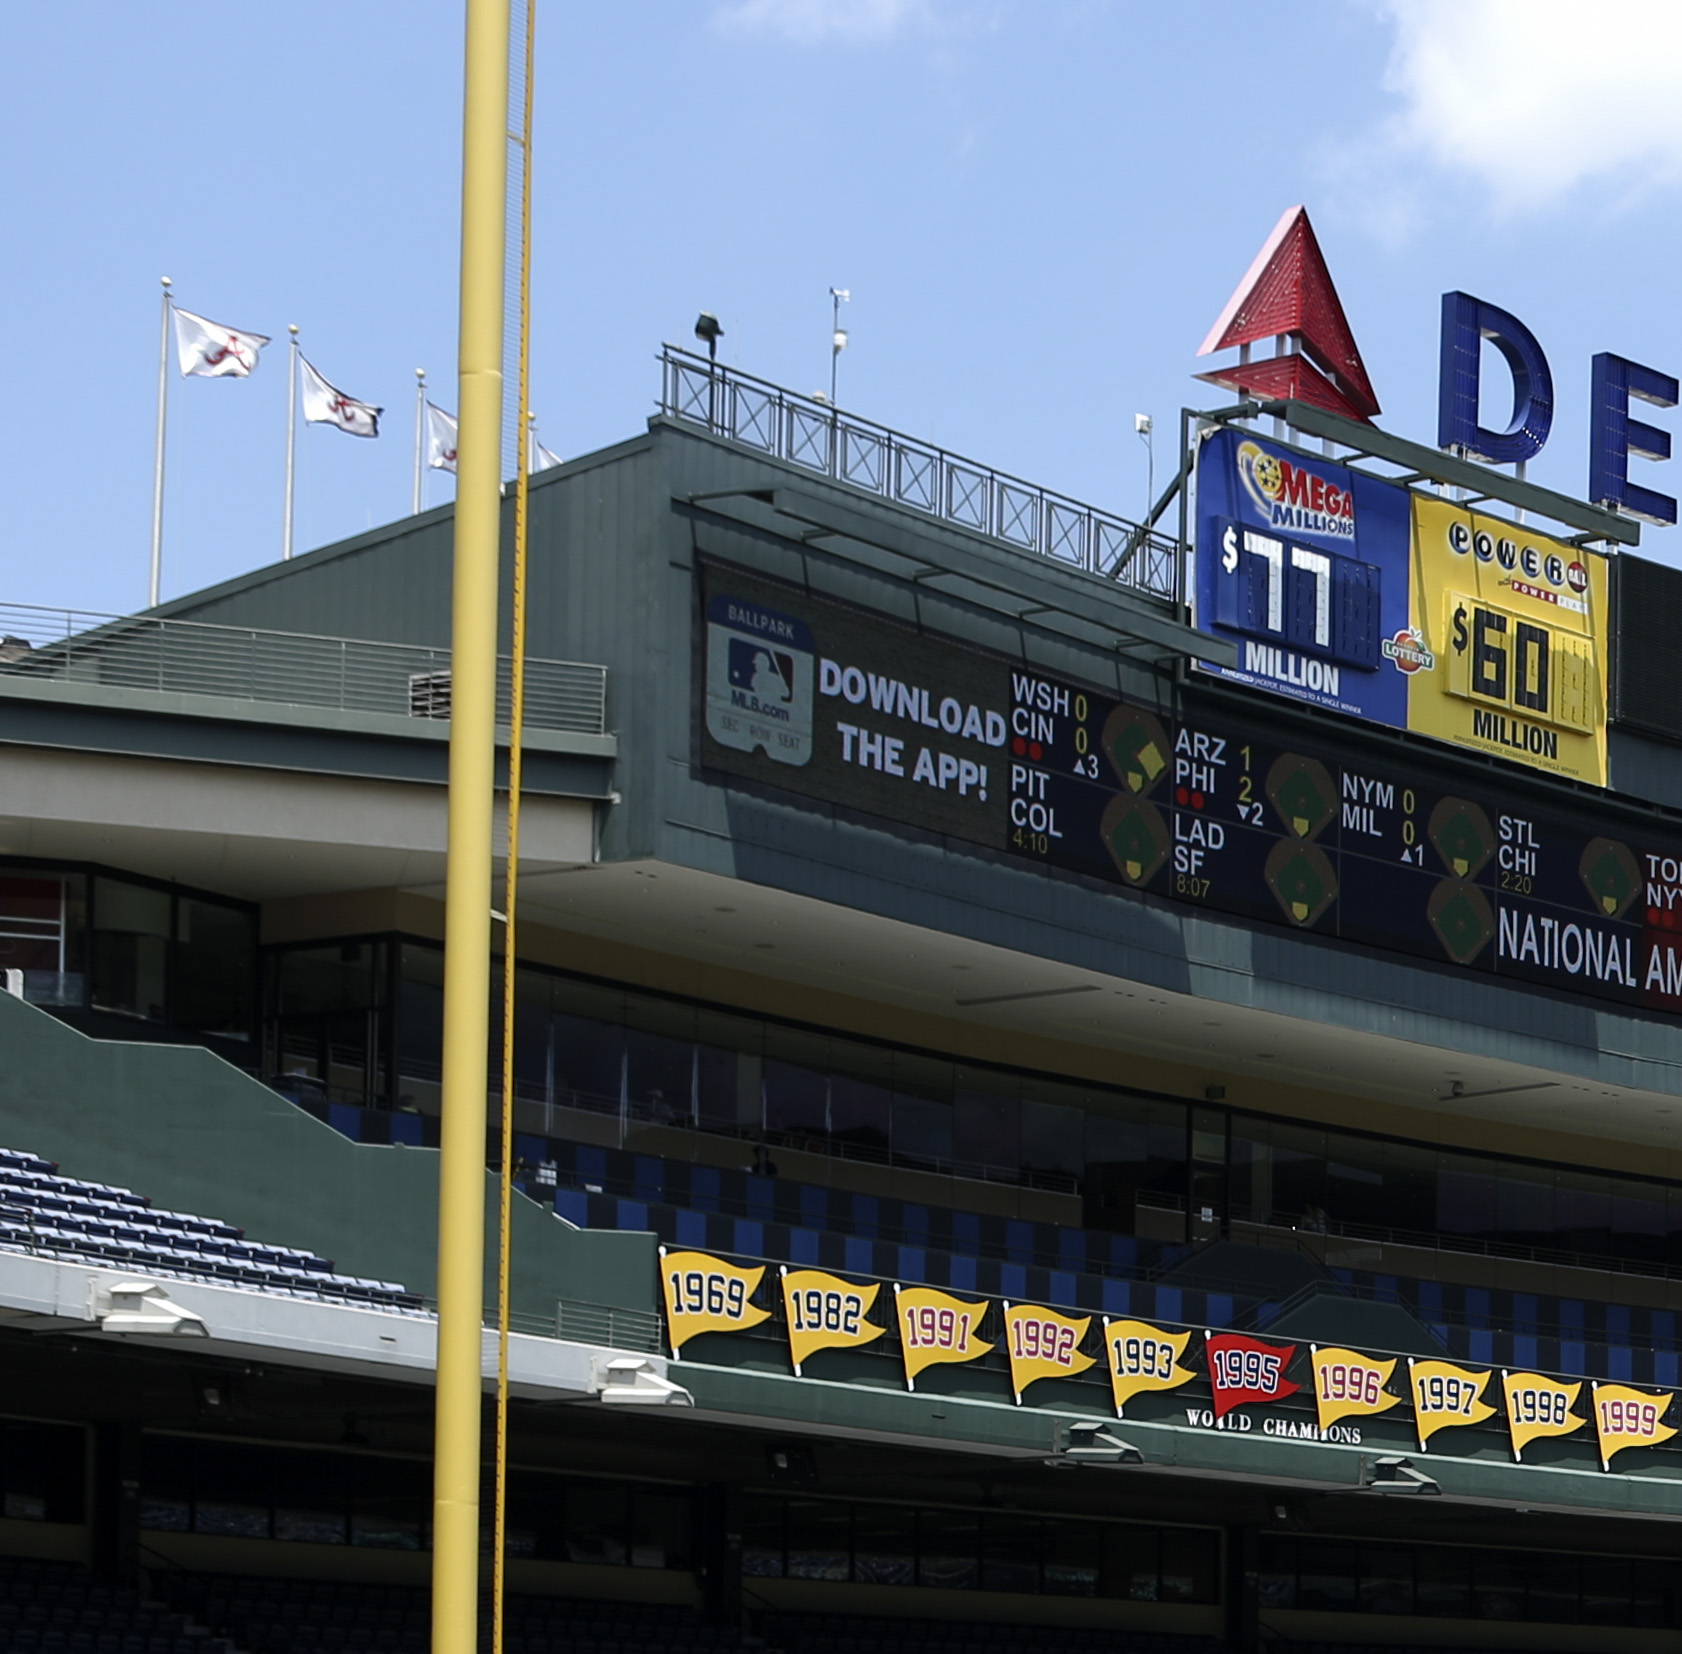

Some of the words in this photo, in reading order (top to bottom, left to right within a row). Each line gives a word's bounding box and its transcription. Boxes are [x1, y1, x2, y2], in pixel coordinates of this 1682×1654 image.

[1276, 459, 1353, 519] MEGA
[1272, 504, 1354, 537] MILLIONS
[1452, 523, 1564, 584] POWER
[1513, 582, 1554, 603] POWER
[1568, 568, 1587, 587] BALL
[727, 604, 794, 640] BALLPARK
[1245, 641, 1340, 696] MILLION
[1385, 644, 1431, 667] LOTTERY
[1452, 602, 1549, 713] $60
[731, 689, 789, 721] MLB.com
[819, 657, 1007, 747] DOWNLOAD
[1012, 673, 1069, 717] WSH
[1075, 695, 1087, 722] 0
[1012, 707, 1054, 744] CIN
[1075, 727, 1087, 754] 0
[1175, 728, 1226, 765] ARZ
[1241, 746, 1250, 771] 1
[1473, 709, 1558, 760] MILLION
[837, 721, 904, 777] THE
[912, 747, 987, 801] APP!
[1012, 764, 1050, 800] PIT
[1088, 754, 1099, 779] 3
[1176, 758, 1215, 793] PHI
[1239, 776, 1251, 803] 2
[1342, 772, 1394, 810] NYM
[1403, 789, 1414, 814] 0
[1011, 798, 1062, 838] COL
[1175, 813, 1224, 849] LAD
[1252, 803, 1264, 826] 2
[1342, 802, 1382, 837] MIL
[1403, 820, 1414, 845] 0
[1499, 815, 1540, 849] STL
[1013, 828, 1047, 854] 4:10
[1174, 845, 1204, 875] SF
[1499, 845, 1536, 876] CHI
[1177, 874, 1210, 898] 8:07
[1501, 871, 1531, 894] 2:20
[1499, 907, 1636, 988] NATIONAL
[671, 1271, 746, 1319] 1969
[791, 1289, 862, 1336] 1982
[906, 1306, 970, 1352] 1991
[1013, 1319, 1076, 1367] 1992
[1113, 1338, 1174, 1380] 1993
[1214, 1349, 1281, 1394] 1995
[1319, 1364, 1382, 1406] 1996
[1417, 1376, 1477, 1416] 1997
[1511, 1388, 1569, 1426] 1998
[1600, 1400, 1658, 1437] 1999
